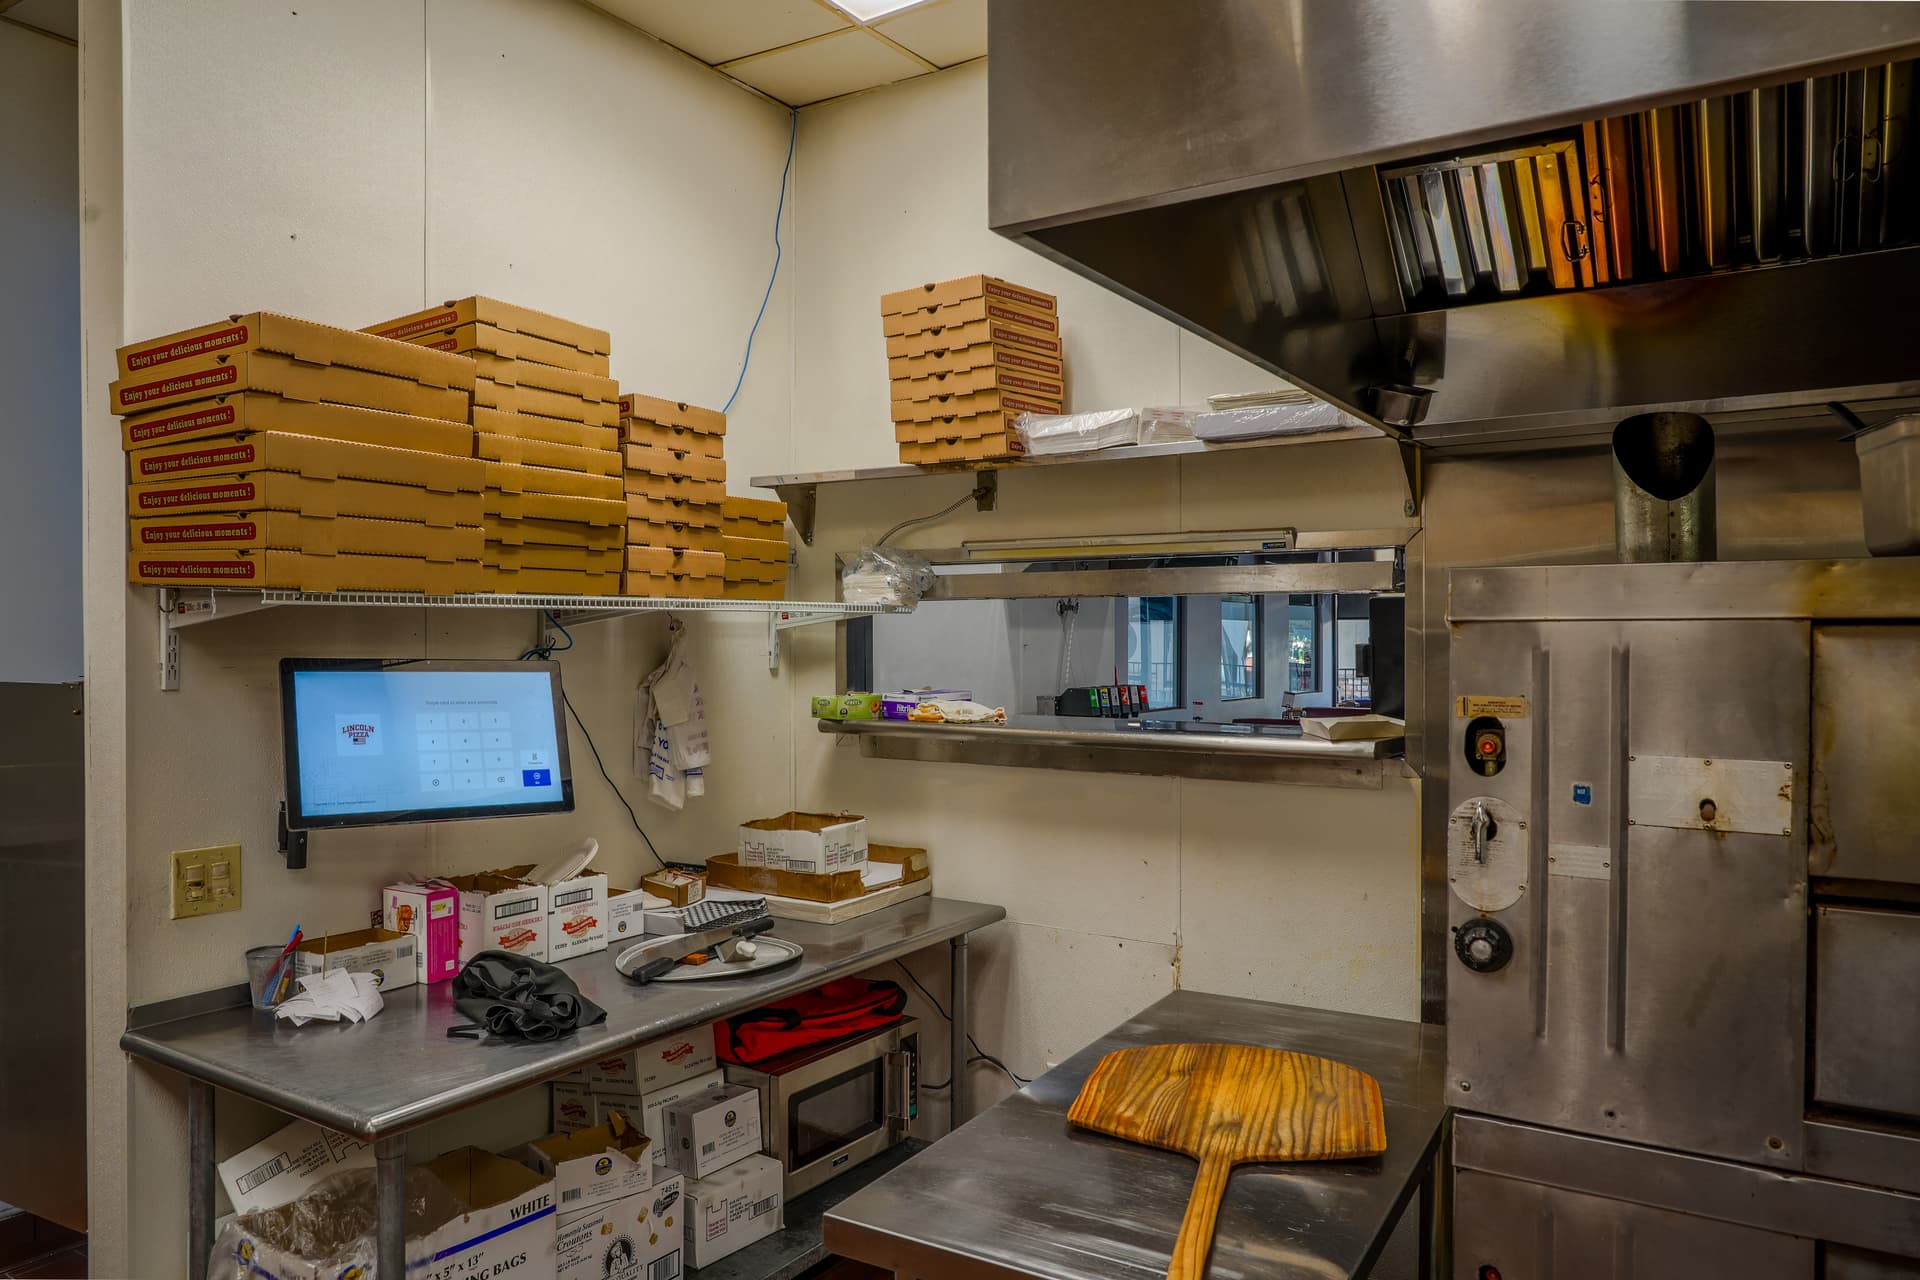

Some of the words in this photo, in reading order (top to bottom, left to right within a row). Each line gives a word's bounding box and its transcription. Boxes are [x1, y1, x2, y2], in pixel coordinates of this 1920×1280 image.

[132, 355, 151, 367] Enjoy
[152, 351, 168, 363] your
[171, 342, 202, 357] delicious
[124, 391, 142, 401] Enjoy
[144, 387, 160, 398] your
[162, 380, 192, 393] delicious
[134, 428, 150, 438] Enjoy
[152, 425, 166, 436] your
[167, 419, 195, 431] delicious
[144, 462, 162, 472] Enjoy
[164, 460, 179, 470] your
[181, 456, 211, 467] delicious
[143, 496, 161, 506] Enjoy
[163, 495, 178, 505] your
[180, 491, 211, 502] delicious
[145, 531, 163, 540] Enjoy
[165, 530, 180, 540] your
[182, 529, 213, 538] delicious
[143, 565, 161, 575] Enjoy
[163, 566, 179, 575] your
[180, 565, 211, 574] delicious
[342, 723, 375, 734] LINCOLN
[510, 1194, 550, 1220] WHITE
[556, 1230, 593, 1252] Croutons
[493, 1252, 527, 1276] BAGS
